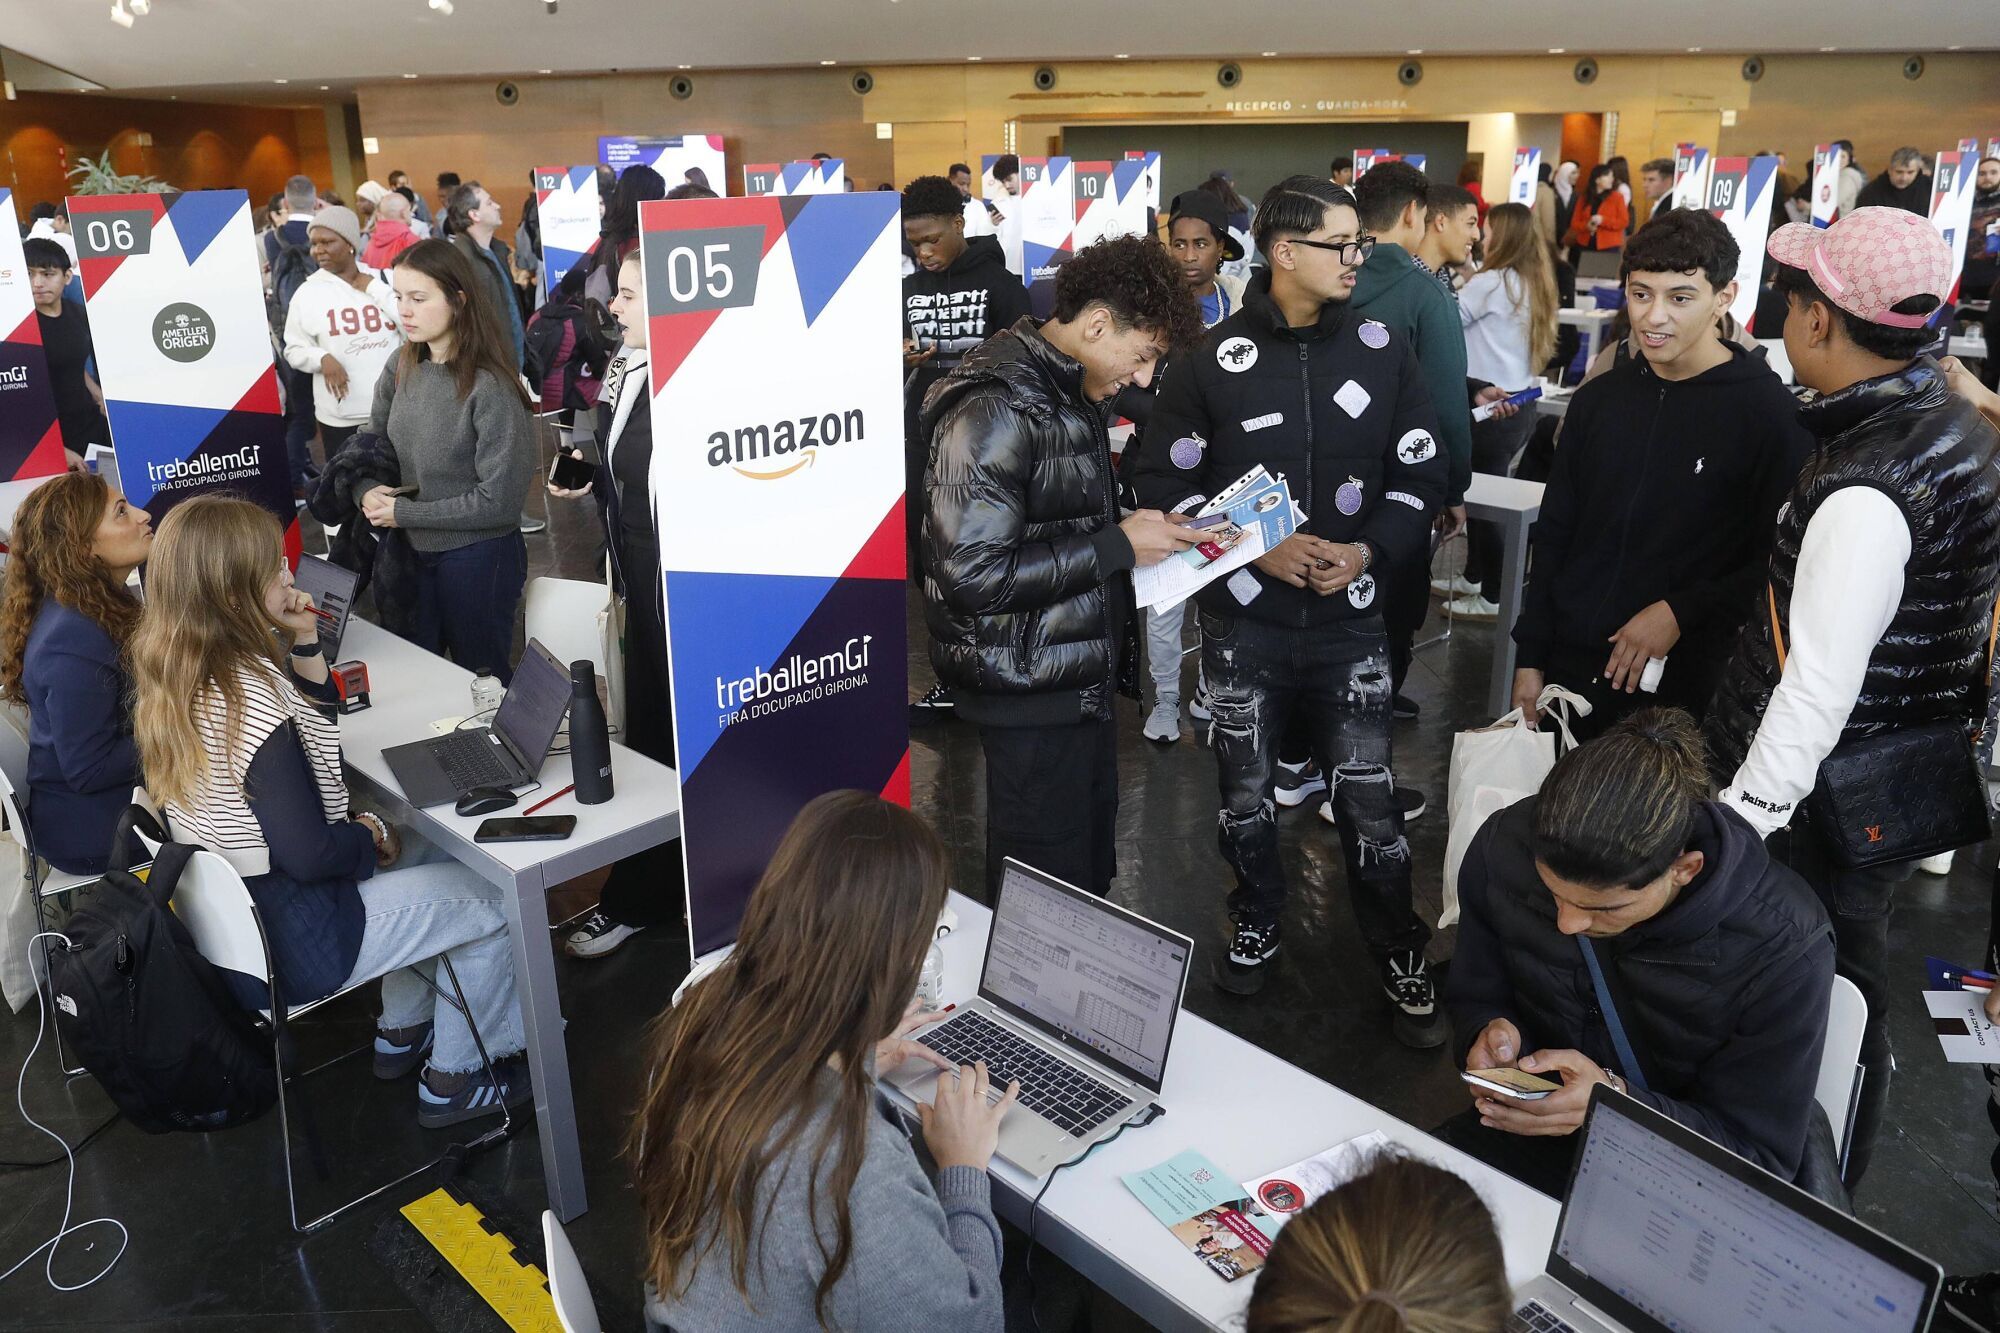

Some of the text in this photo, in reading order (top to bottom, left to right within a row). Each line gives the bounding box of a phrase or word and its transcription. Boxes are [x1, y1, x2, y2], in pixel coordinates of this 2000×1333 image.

[1226, 100, 1408, 111] RECEPCIÓ GUARDA-ROBA
[541, 175, 556, 189] 12
[753, 175, 766, 191] 11
[1025, 166, 1036, 180] 16
[1940, 168, 1949, 189] 14
[1081, 177, 1097, 196] 10
[1714, 179, 1732, 207] 09
[87, 219, 134, 252] 06
[667, 243, 734, 302] 05
[162, 326, 208, 339] AMETLLER
[162, 334, 210, 350] ORIGEN
[344, 336, 389, 356] Sports
[2, 382, 28, 391] GIRONA
[707, 408, 864, 467] amazon
[148, 445, 260, 481] treballemGi
[152, 467, 261, 493] FIRA D'OCUPACIÓ GIRONA
[716, 634, 873, 709] treballemGi
[719, 673, 869, 728] FIRA D'OCUPACIÓ GIRONA
[1741, 790, 1768, 809] Palm
[1968, 1008, 1985, 1046] CONTACT US
[1224, 1216, 1245, 1234] nosotros
[1231, 1213, 1271, 1248] Amazon Figueres
[1208, 1257, 1235, 1280] amazon
